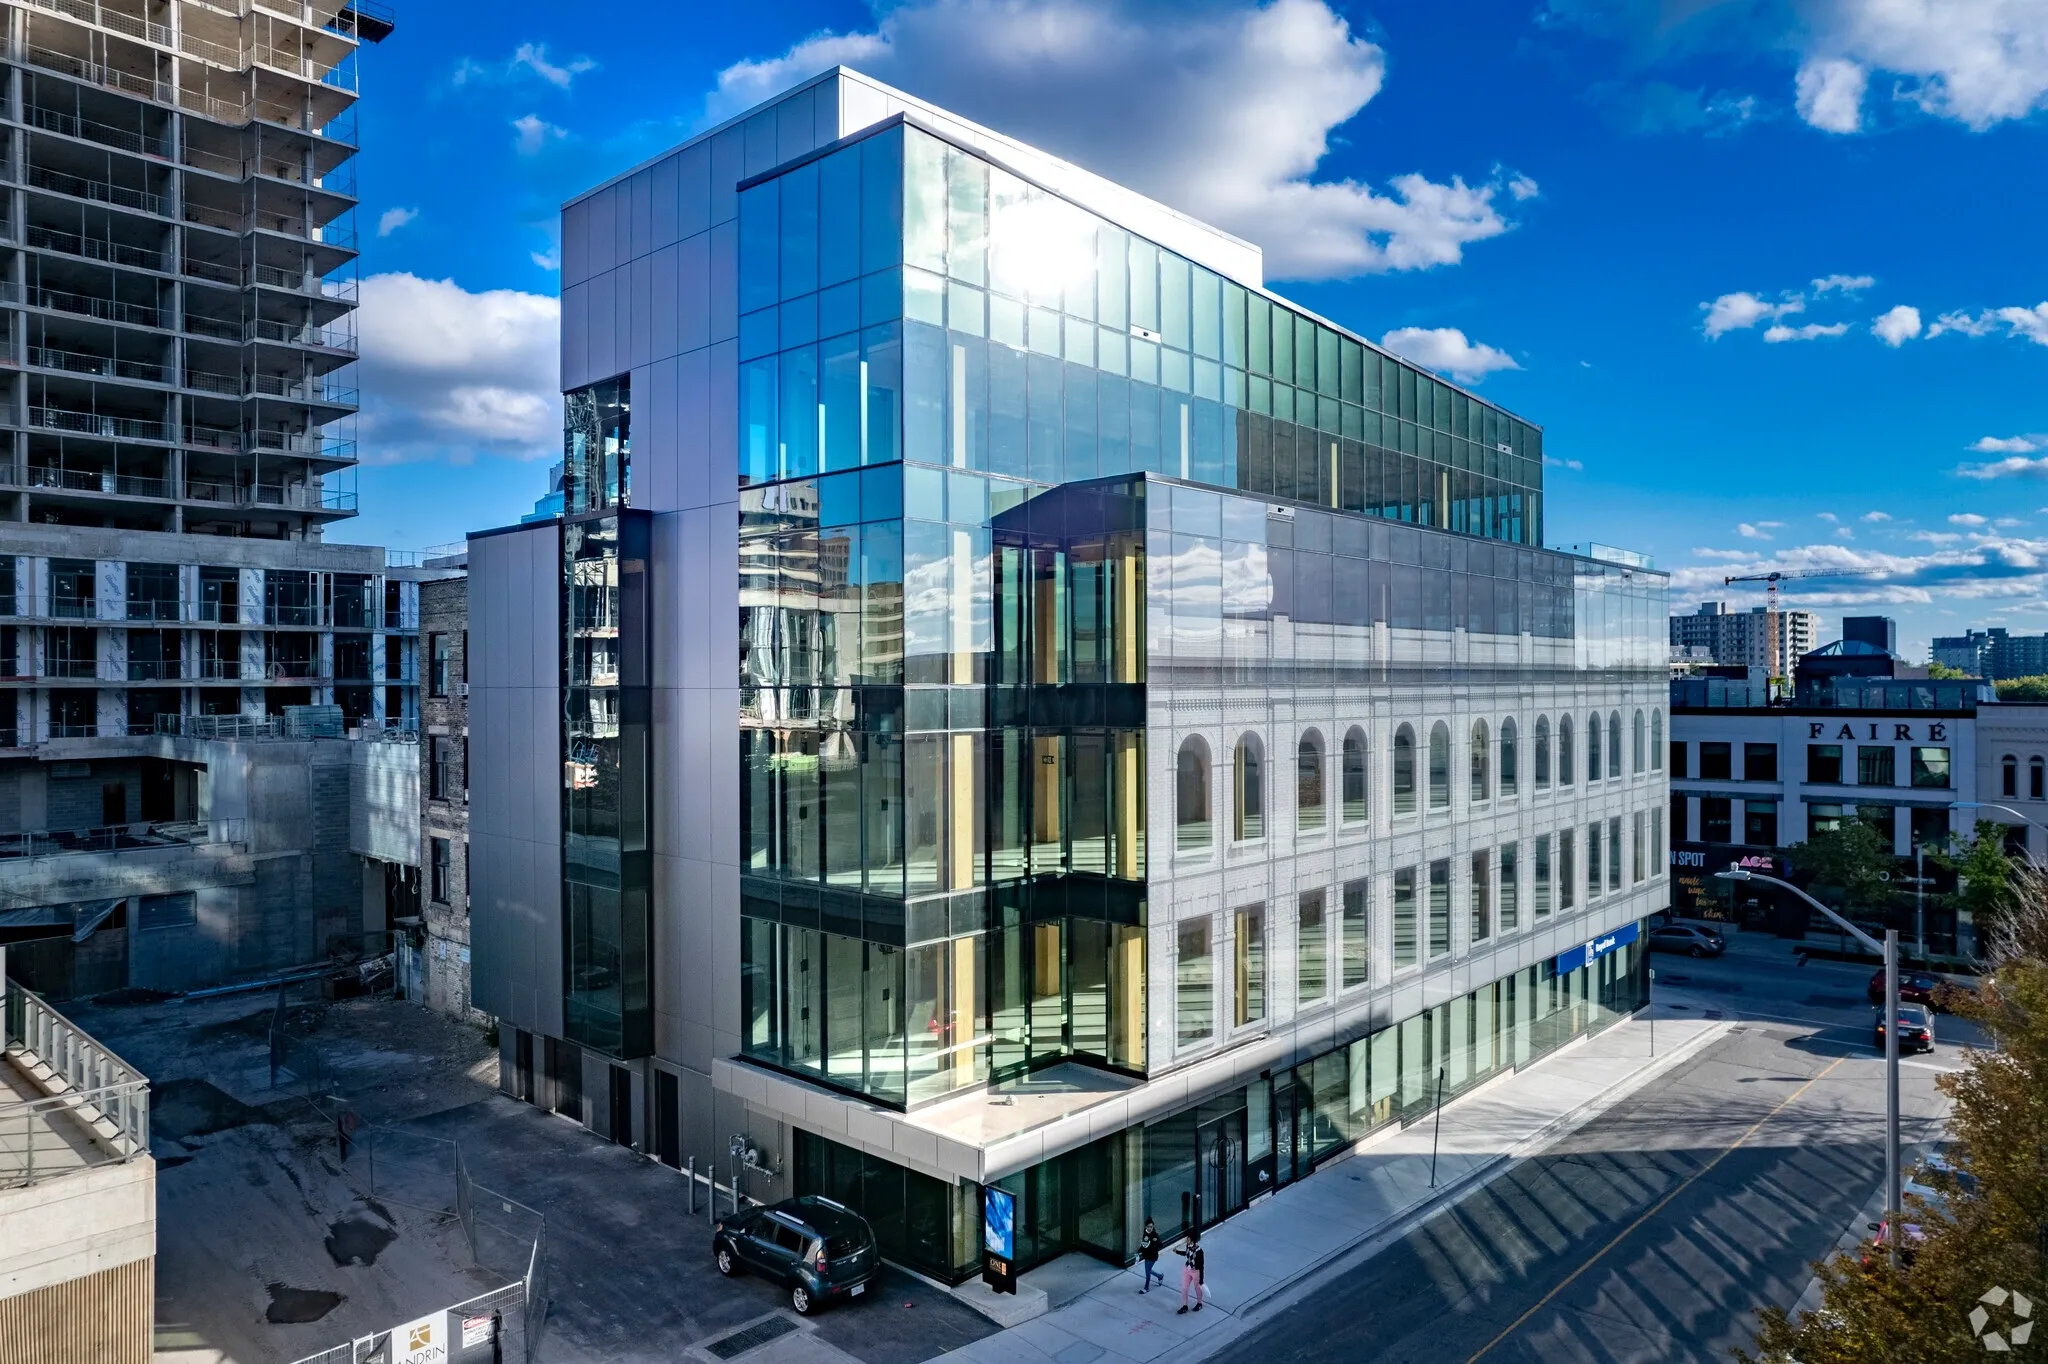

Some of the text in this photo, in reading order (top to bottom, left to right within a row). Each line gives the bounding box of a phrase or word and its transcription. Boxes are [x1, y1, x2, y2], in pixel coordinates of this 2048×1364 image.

[1808, 718, 1947, 742] FAIRÉ
[1678, 851, 1705, 867] SPOT
[397, 1343, 445, 1364] NDRIN
